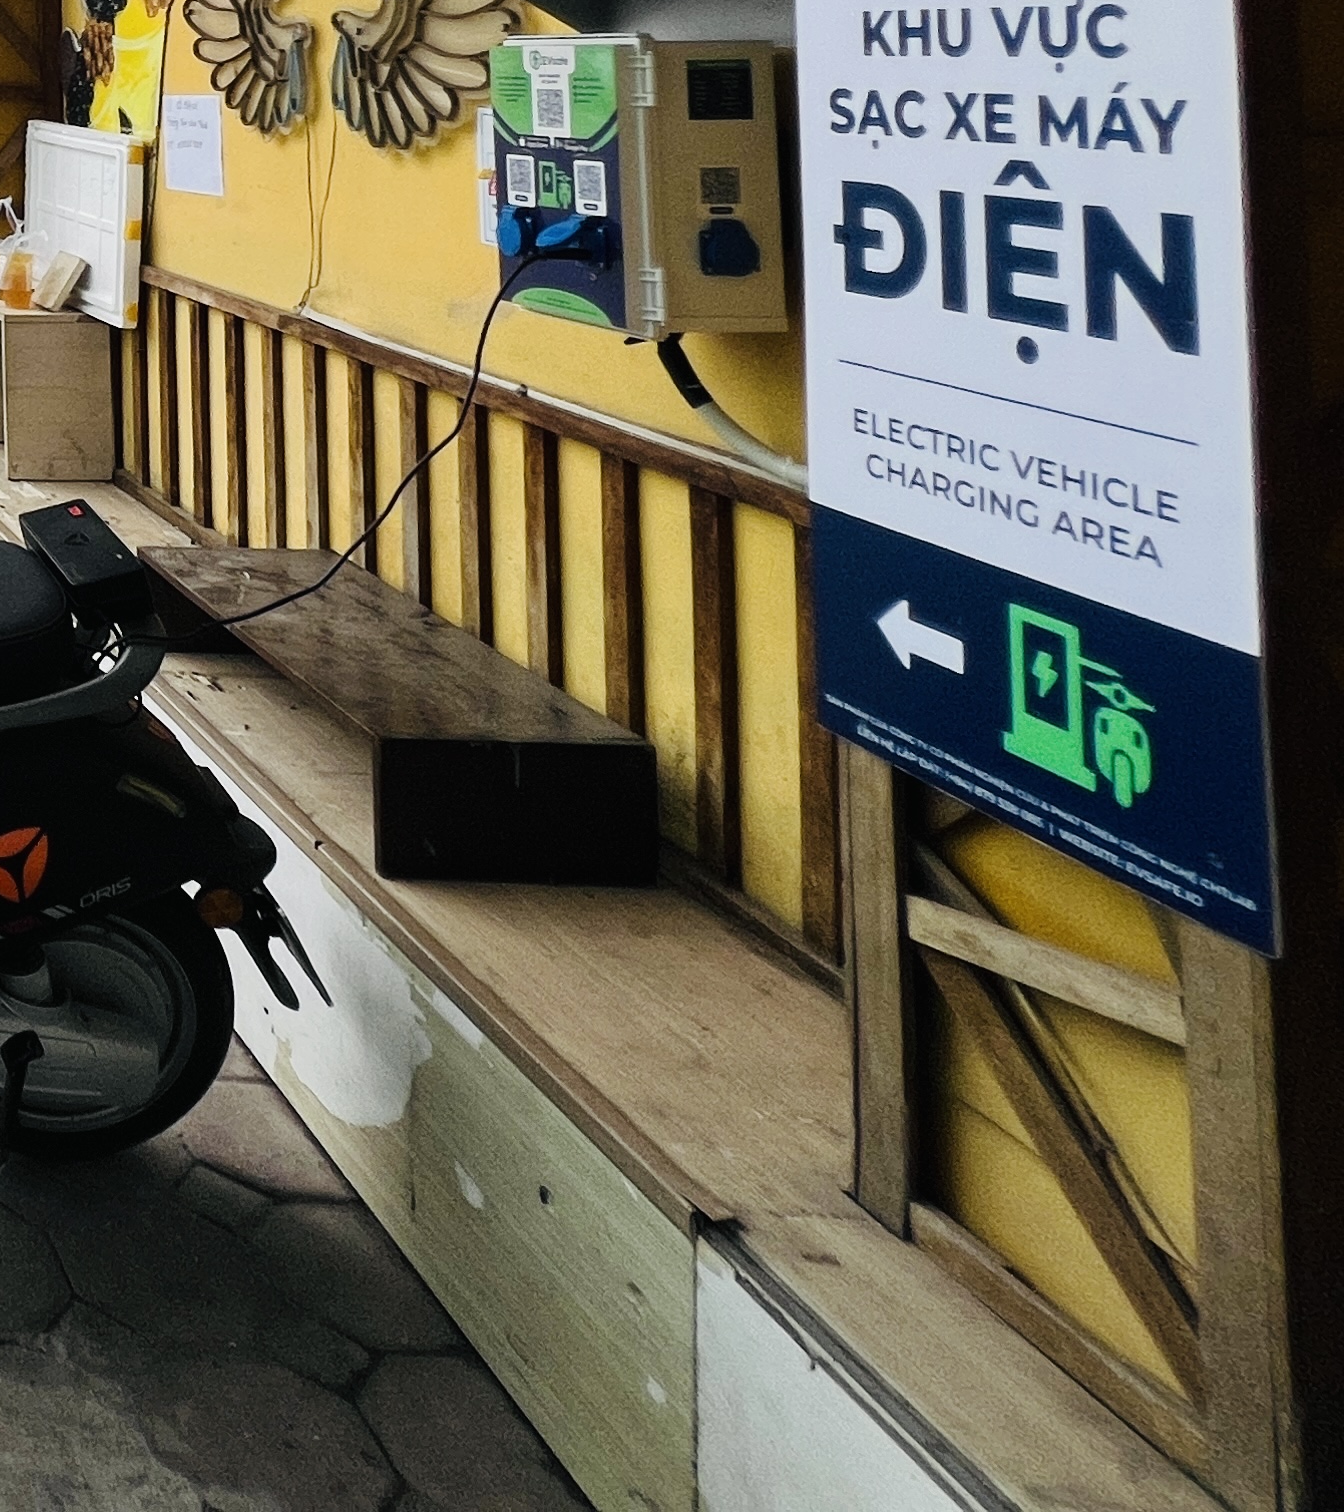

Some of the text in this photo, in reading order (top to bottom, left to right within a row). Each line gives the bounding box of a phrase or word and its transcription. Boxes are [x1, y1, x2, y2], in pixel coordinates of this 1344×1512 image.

[863, 7, 972, 57] KHU
[829, 81, 1188, 154] SẠC XE MÁY
[833, 159, 1201, 365] ĐIỆN
[853, 408, 1181, 523] ELECTRIC VEHICLE
[865, 454, 1163, 568] CHARGING AREA
[79, 877, 131, 908] ORIS
